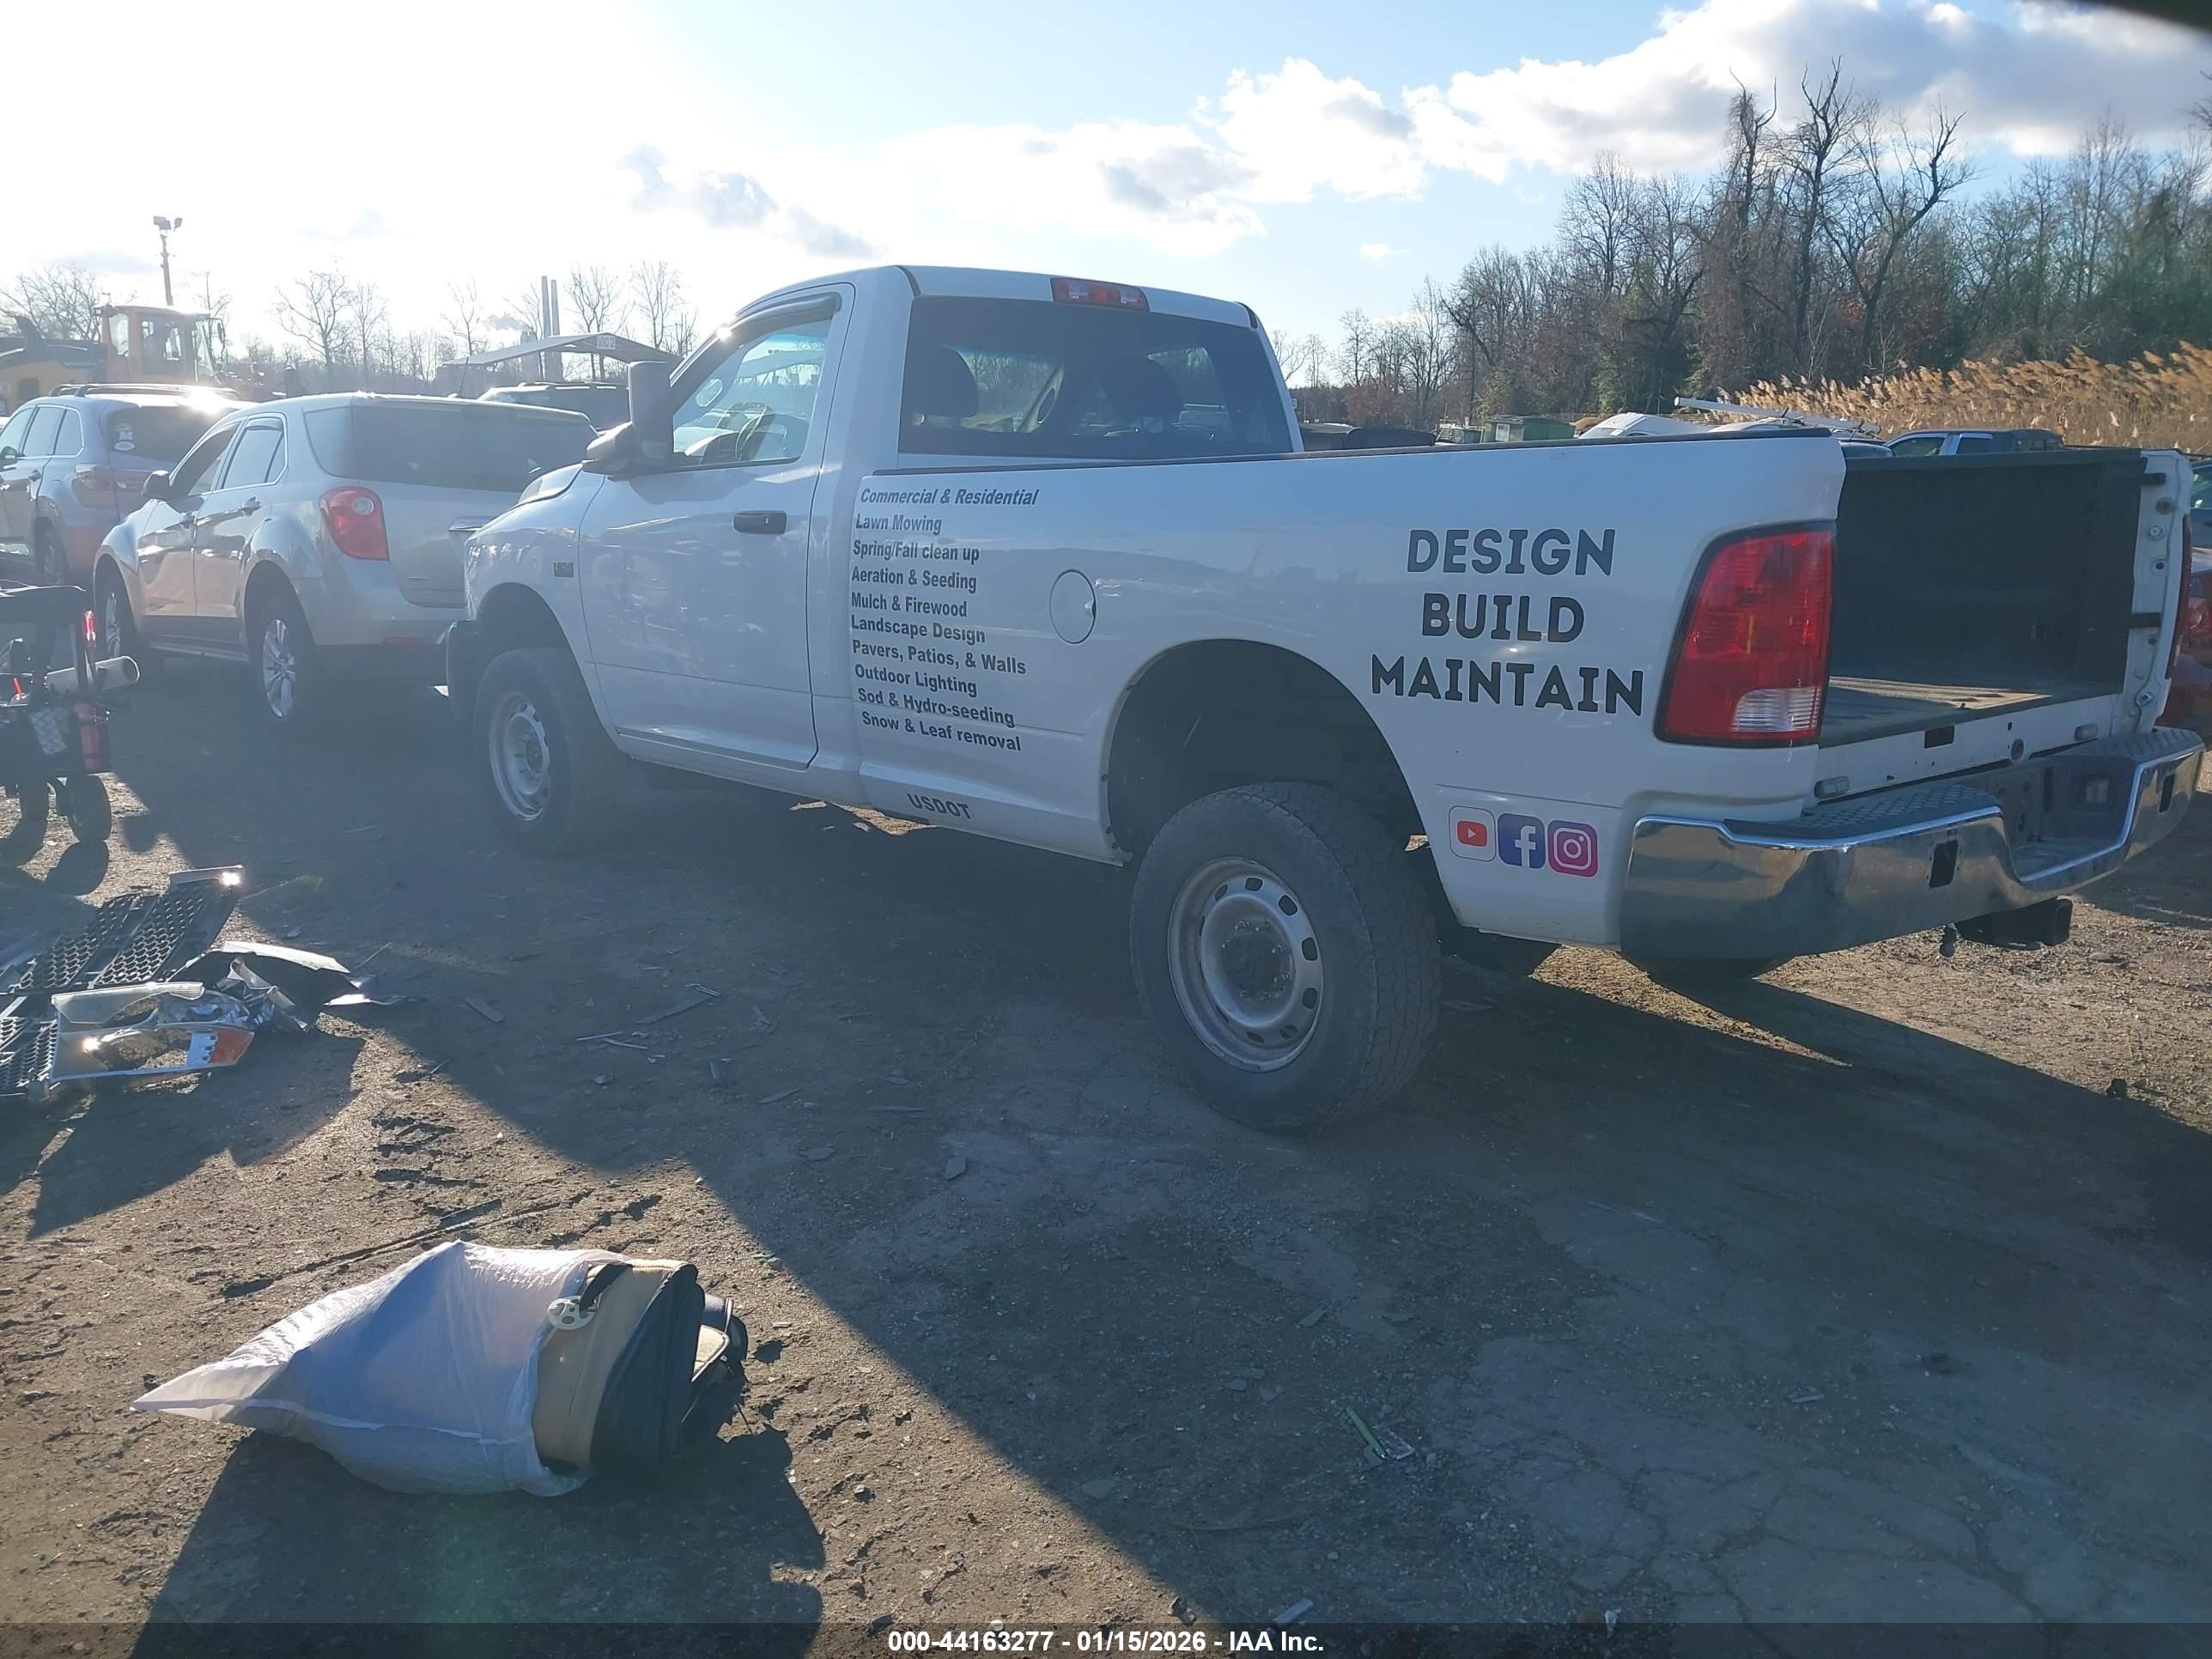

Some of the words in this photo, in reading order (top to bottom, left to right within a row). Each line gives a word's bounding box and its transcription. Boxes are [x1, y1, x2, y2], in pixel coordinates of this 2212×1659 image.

[860, 488, 939, 504] Commercial
[940, 488, 951, 504] &
[954, 489, 1039, 506] Residential
[855, 514, 889, 530] Lawn
[892, 514, 942, 536] Mowing
[854, 539, 918, 561] Spring/Fall
[922, 543, 958, 561] clean
[963, 548, 980, 565] up
[1407, 529, 1615, 575] DESIGN
[851, 566, 903, 585] Aeration
[908, 568, 918, 586] &
[922, 570, 977, 594] Seeding
[851, 592, 887, 611] Mulch
[891, 595, 901, 611] &
[905, 596, 967, 617] Firewood
[1421, 592, 1584, 643] BUILD
[851, 614, 928, 640] Landscape
[933, 623, 986, 646] Design
[852, 639, 903, 663] Pavers,
[908, 645, 960, 670] Patios,
[964, 652, 977, 668] &
[981, 653, 1027, 675] Walls
[854, 664, 910, 684] Outdoor
[915, 672, 977, 697] Lighting
[1371, 653, 1644, 716] MAINTAIN
[858, 688, 883, 704] Sod
[889, 692, 899, 708] &
[903, 694, 1015, 728] Hydro-seeding
[861, 711, 899, 730] Snow
[904, 718, 915, 733] &
[919, 720, 952, 740] Leaf
[957, 729, 1022, 751] removal
[907, 793, 971, 819] USDOT
